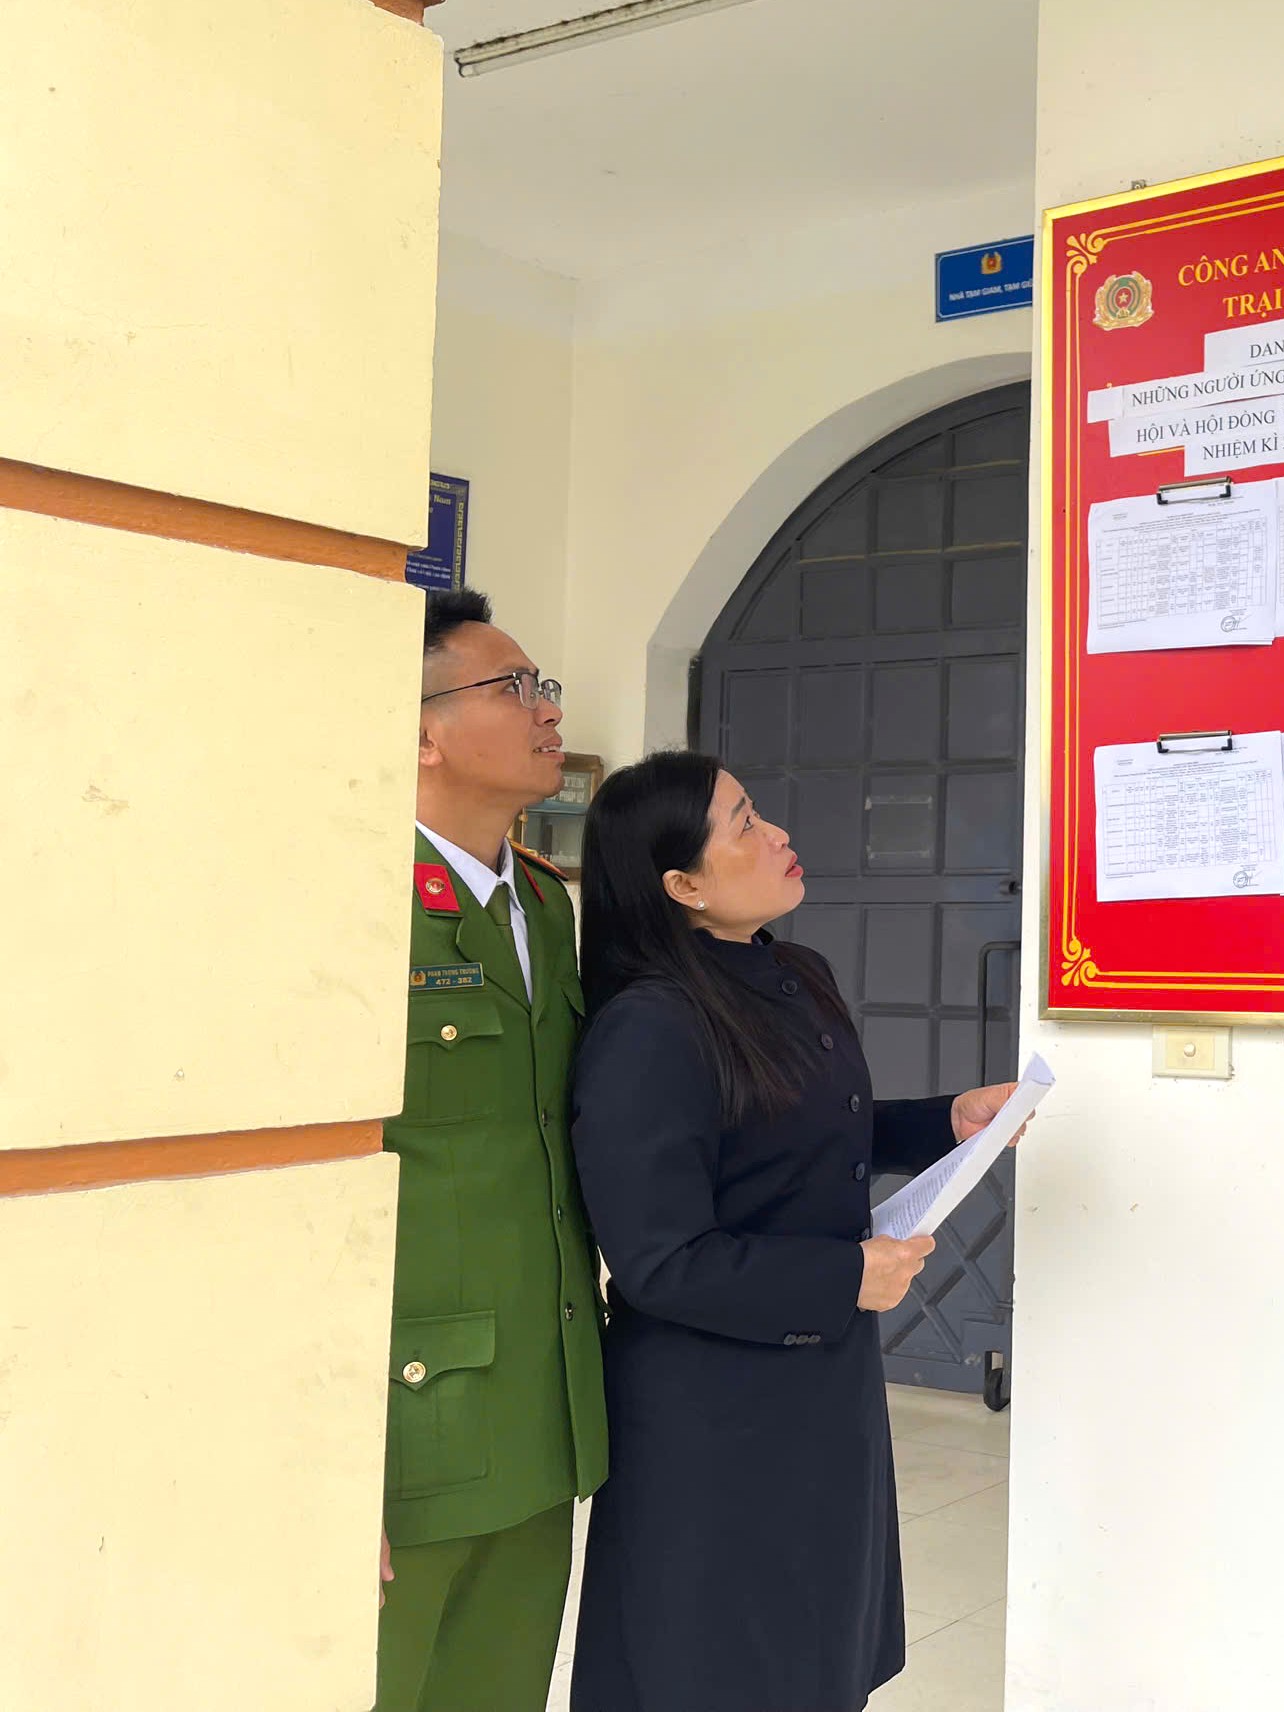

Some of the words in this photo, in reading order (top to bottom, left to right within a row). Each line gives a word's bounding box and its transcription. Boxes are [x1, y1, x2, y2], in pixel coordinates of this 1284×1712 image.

[1178, 253, 1249, 287] CÔNG
[1223, 288, 1283, 318] TRẠI
[1132, 384, 1190, 407] NHỮNG
[1193, 372, 1245, 396] NGƯỜI
[1137, 423, 1164, 444] HỘI
[1168, 418, 1191, 438] VÀ
[1195, 414, 1224, 435] HỘI
[1203, 439, 1257, 460] NHIỆM
[1261, 432, 1278, 453] KÌ
